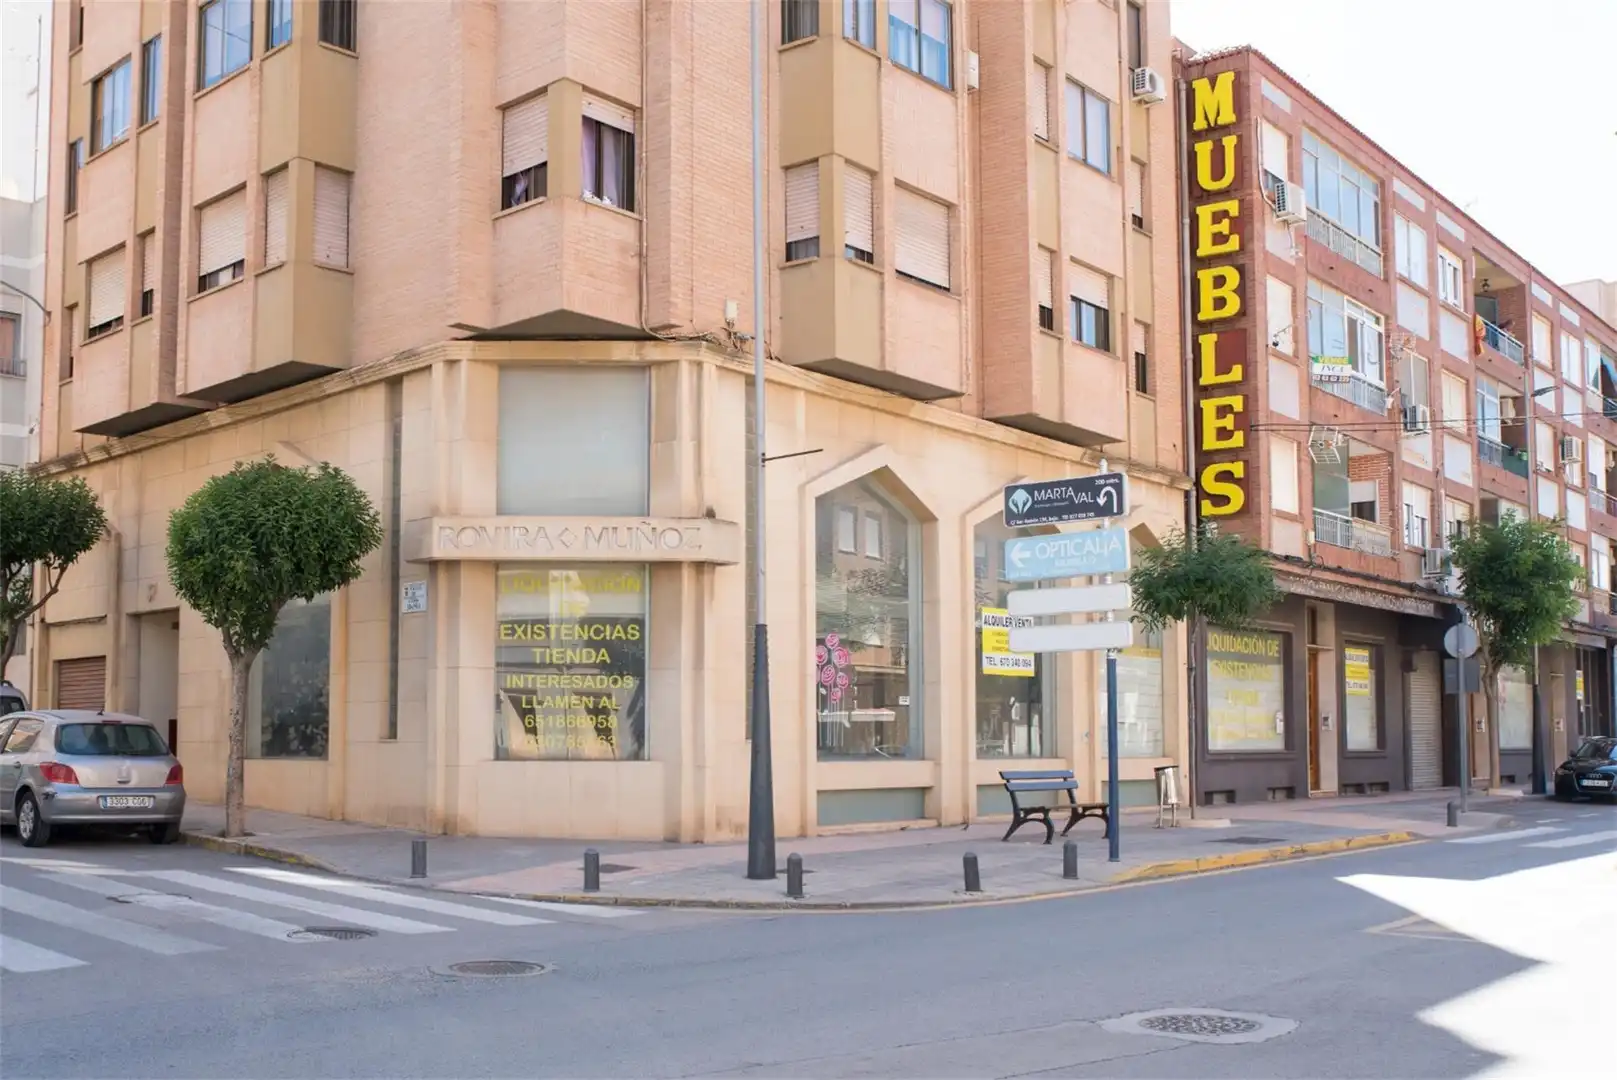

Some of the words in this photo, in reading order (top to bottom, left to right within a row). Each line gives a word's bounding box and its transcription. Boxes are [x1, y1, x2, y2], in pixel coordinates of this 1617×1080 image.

[1191, 70, 1246, 517] MUEBLES
[438, 526, 554, 549] ROVIRA
[584, 521, 703, 550] MUÑOZ
[1035, 535, 1122, 560] OPTICALIA
[983, 614, 1012, 628] ALQUILER
[500, 624, 641, 640] EXISTENCIAS
[1207, 631, 1265, 656] IQUIDACIÓN
[1267, 639, 1280, 657] DE
[532, 648, 611, 664] TIENDA
[506, 674, 634, 689] INTERESADOS
[522, 695, 594, 709] LLAMEN
[599, 695, 622, 709] AL
